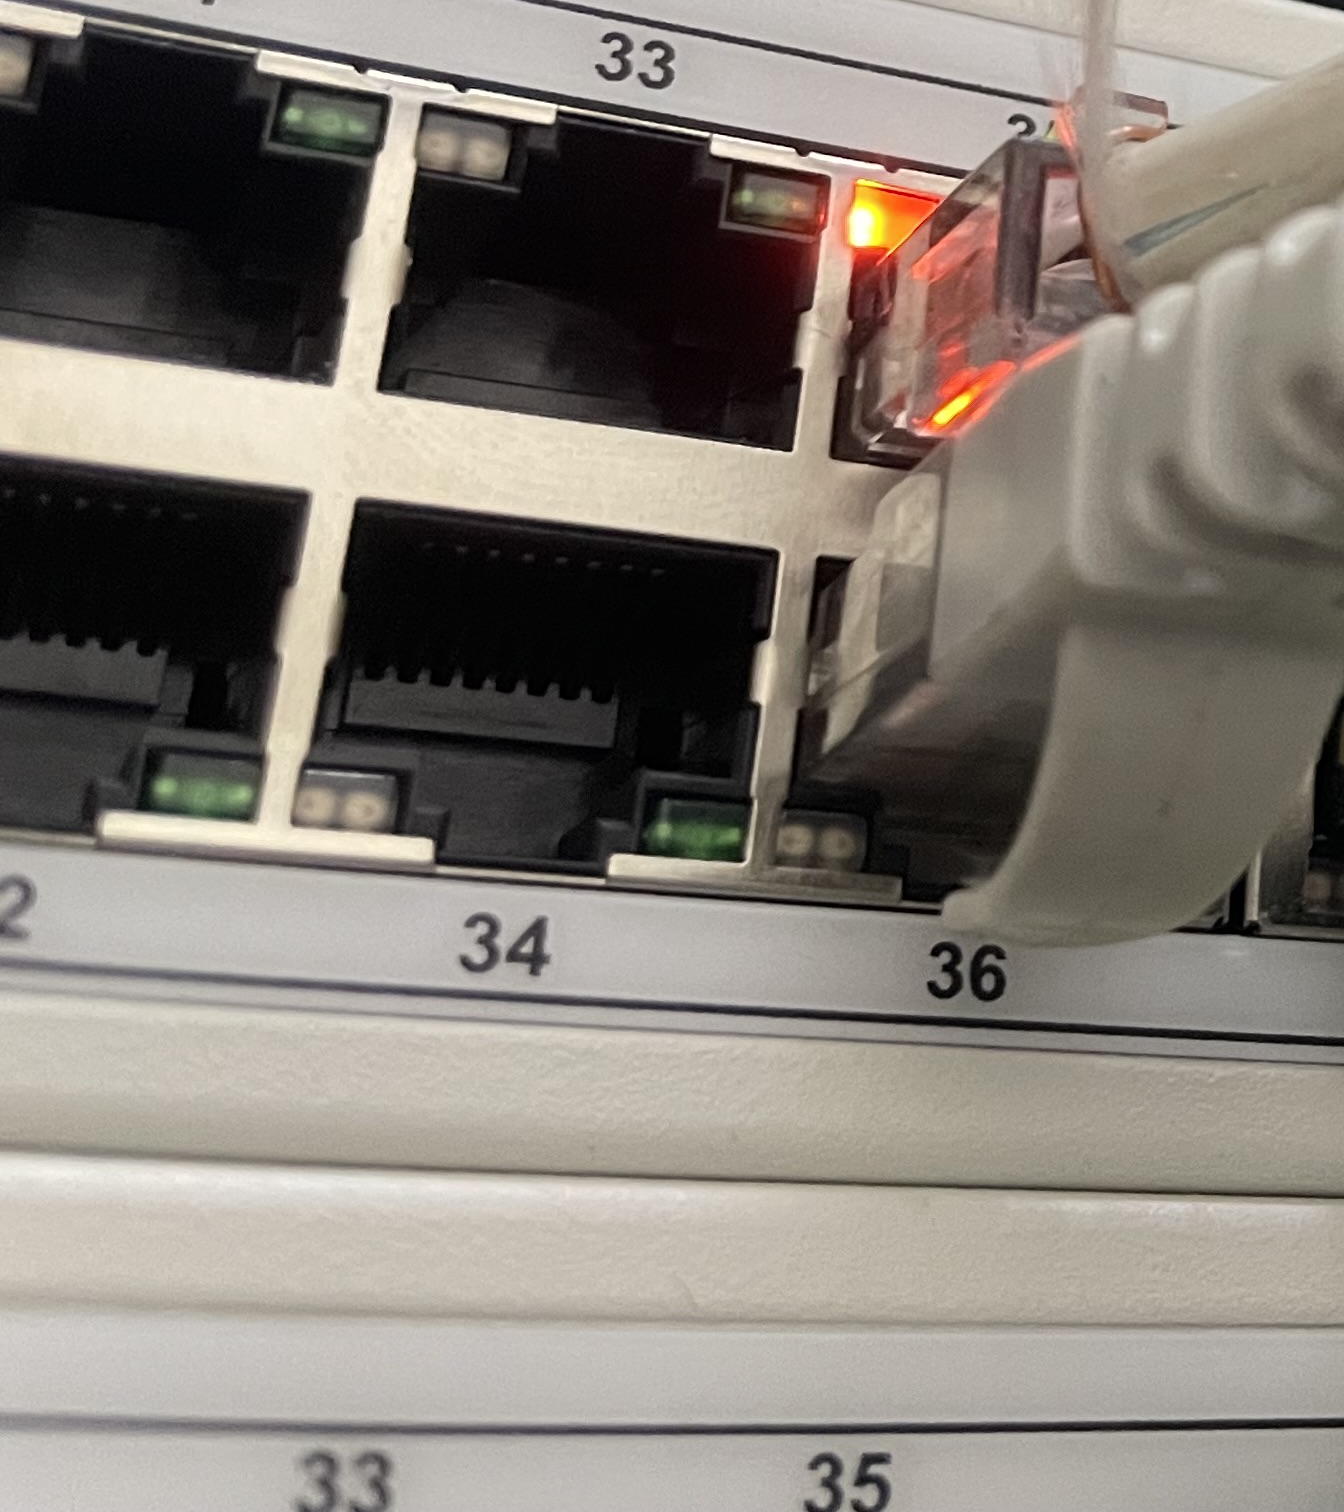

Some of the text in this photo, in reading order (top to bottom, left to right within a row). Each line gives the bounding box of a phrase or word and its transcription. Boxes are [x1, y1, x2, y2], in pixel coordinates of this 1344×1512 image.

[594, 29, 678, 92] 33
[458, 913, 550, 979] 34
[926, 941, 1007, 1003] 36
[296, 1450, 394, 1512] 33
[803, 1451, 892, 1512] 35
